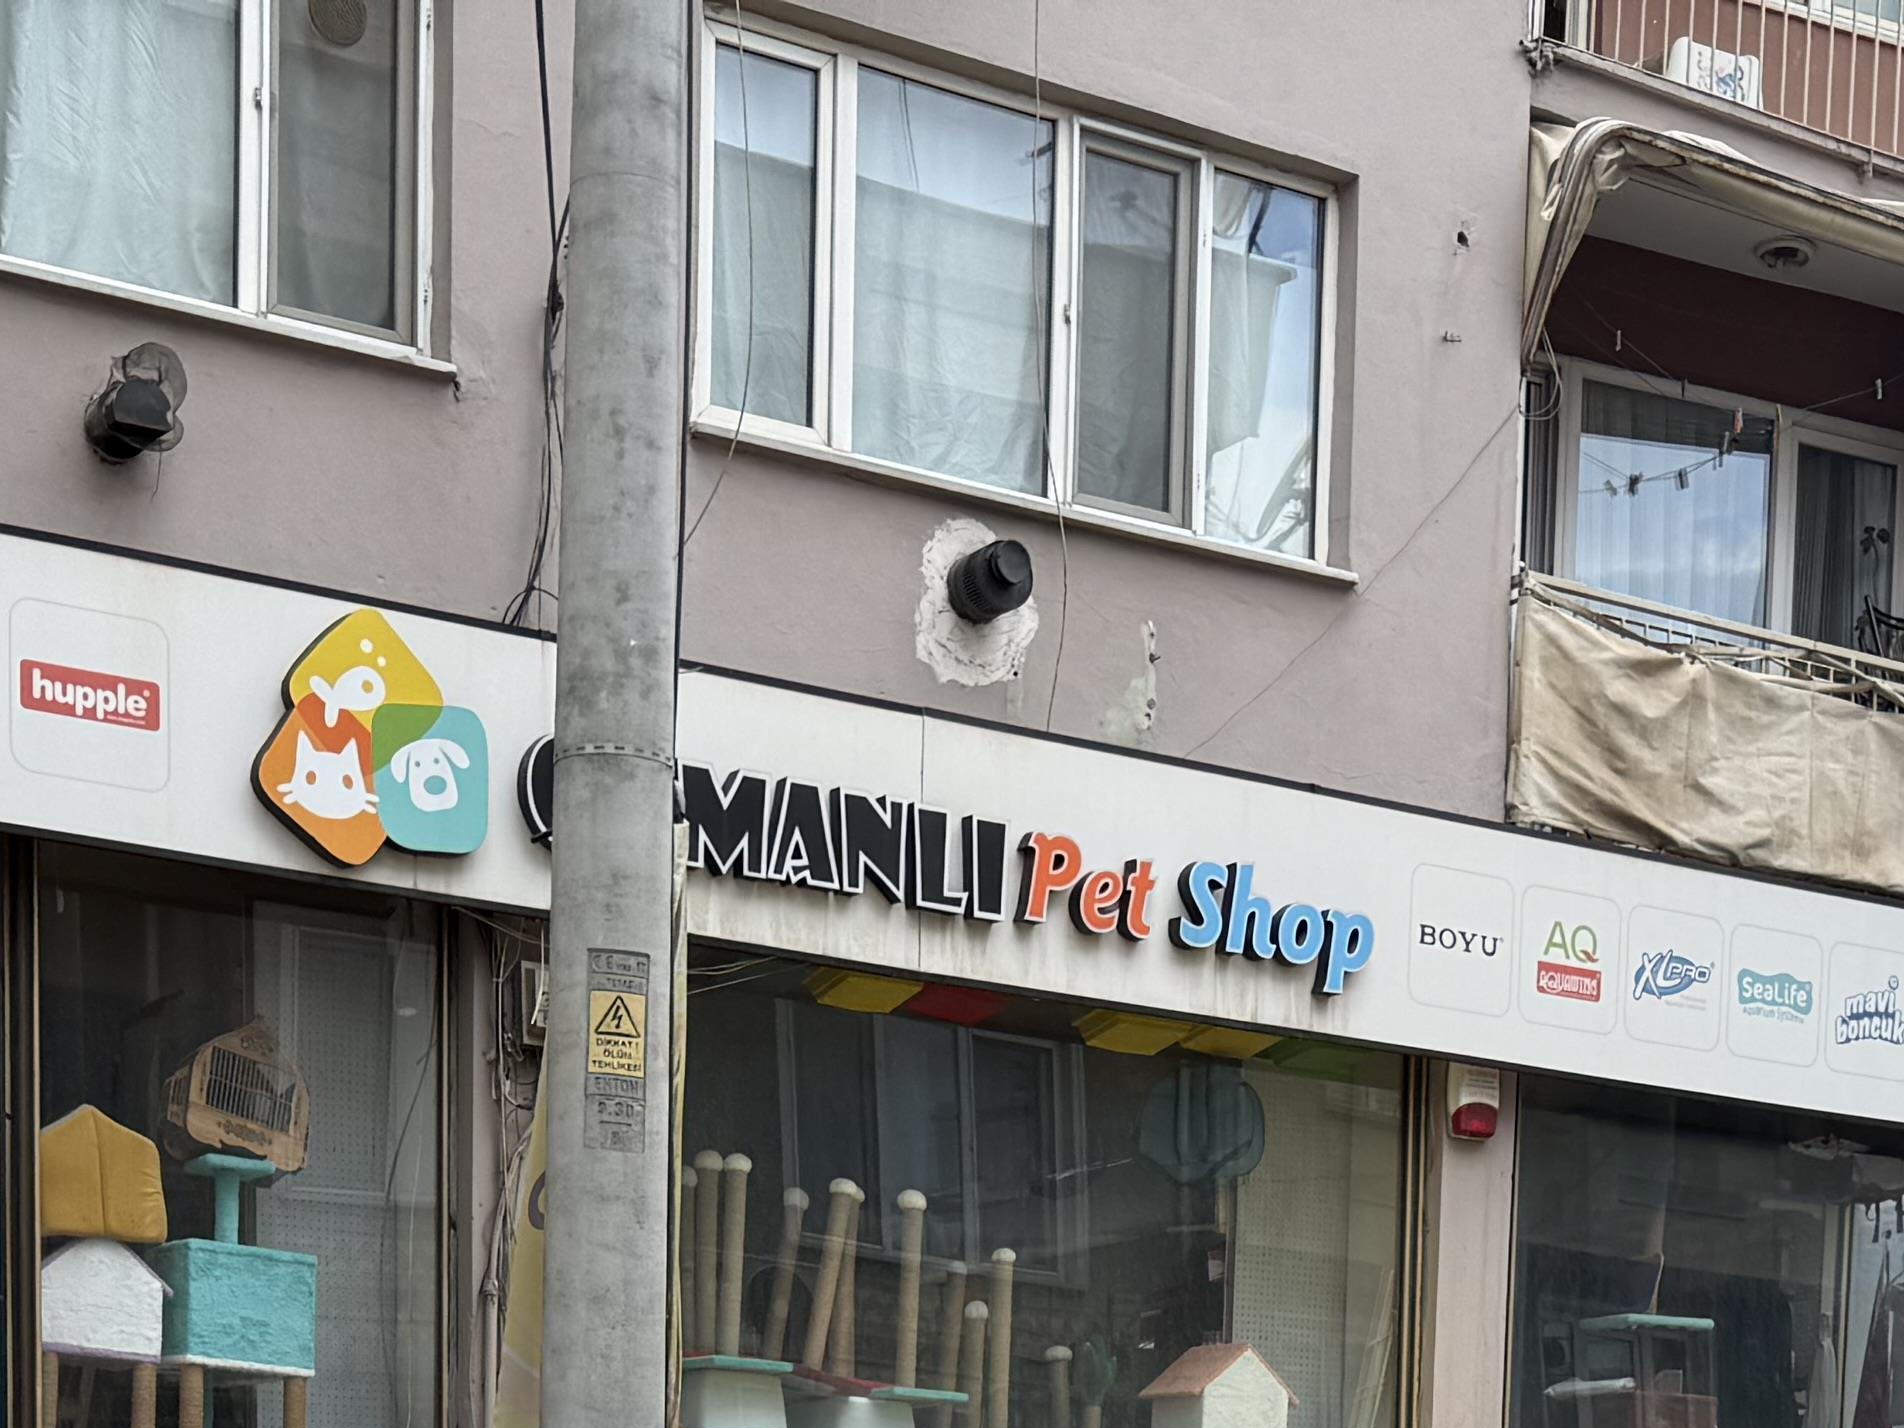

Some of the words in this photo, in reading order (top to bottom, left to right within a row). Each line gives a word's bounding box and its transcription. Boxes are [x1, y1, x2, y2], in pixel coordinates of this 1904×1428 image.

[31, 667, 148, 720] hupple
[518, 732, 1013, 923] MANLI
[1018, 830, 1157, 942] Pet
[1171, 858, 1376, 996] Shop
[1418, 923, 1499, 957] BOYU
[1542, 919, 1600, 963] AQ
[1741, 976, 1808, 1009] SeaLife
